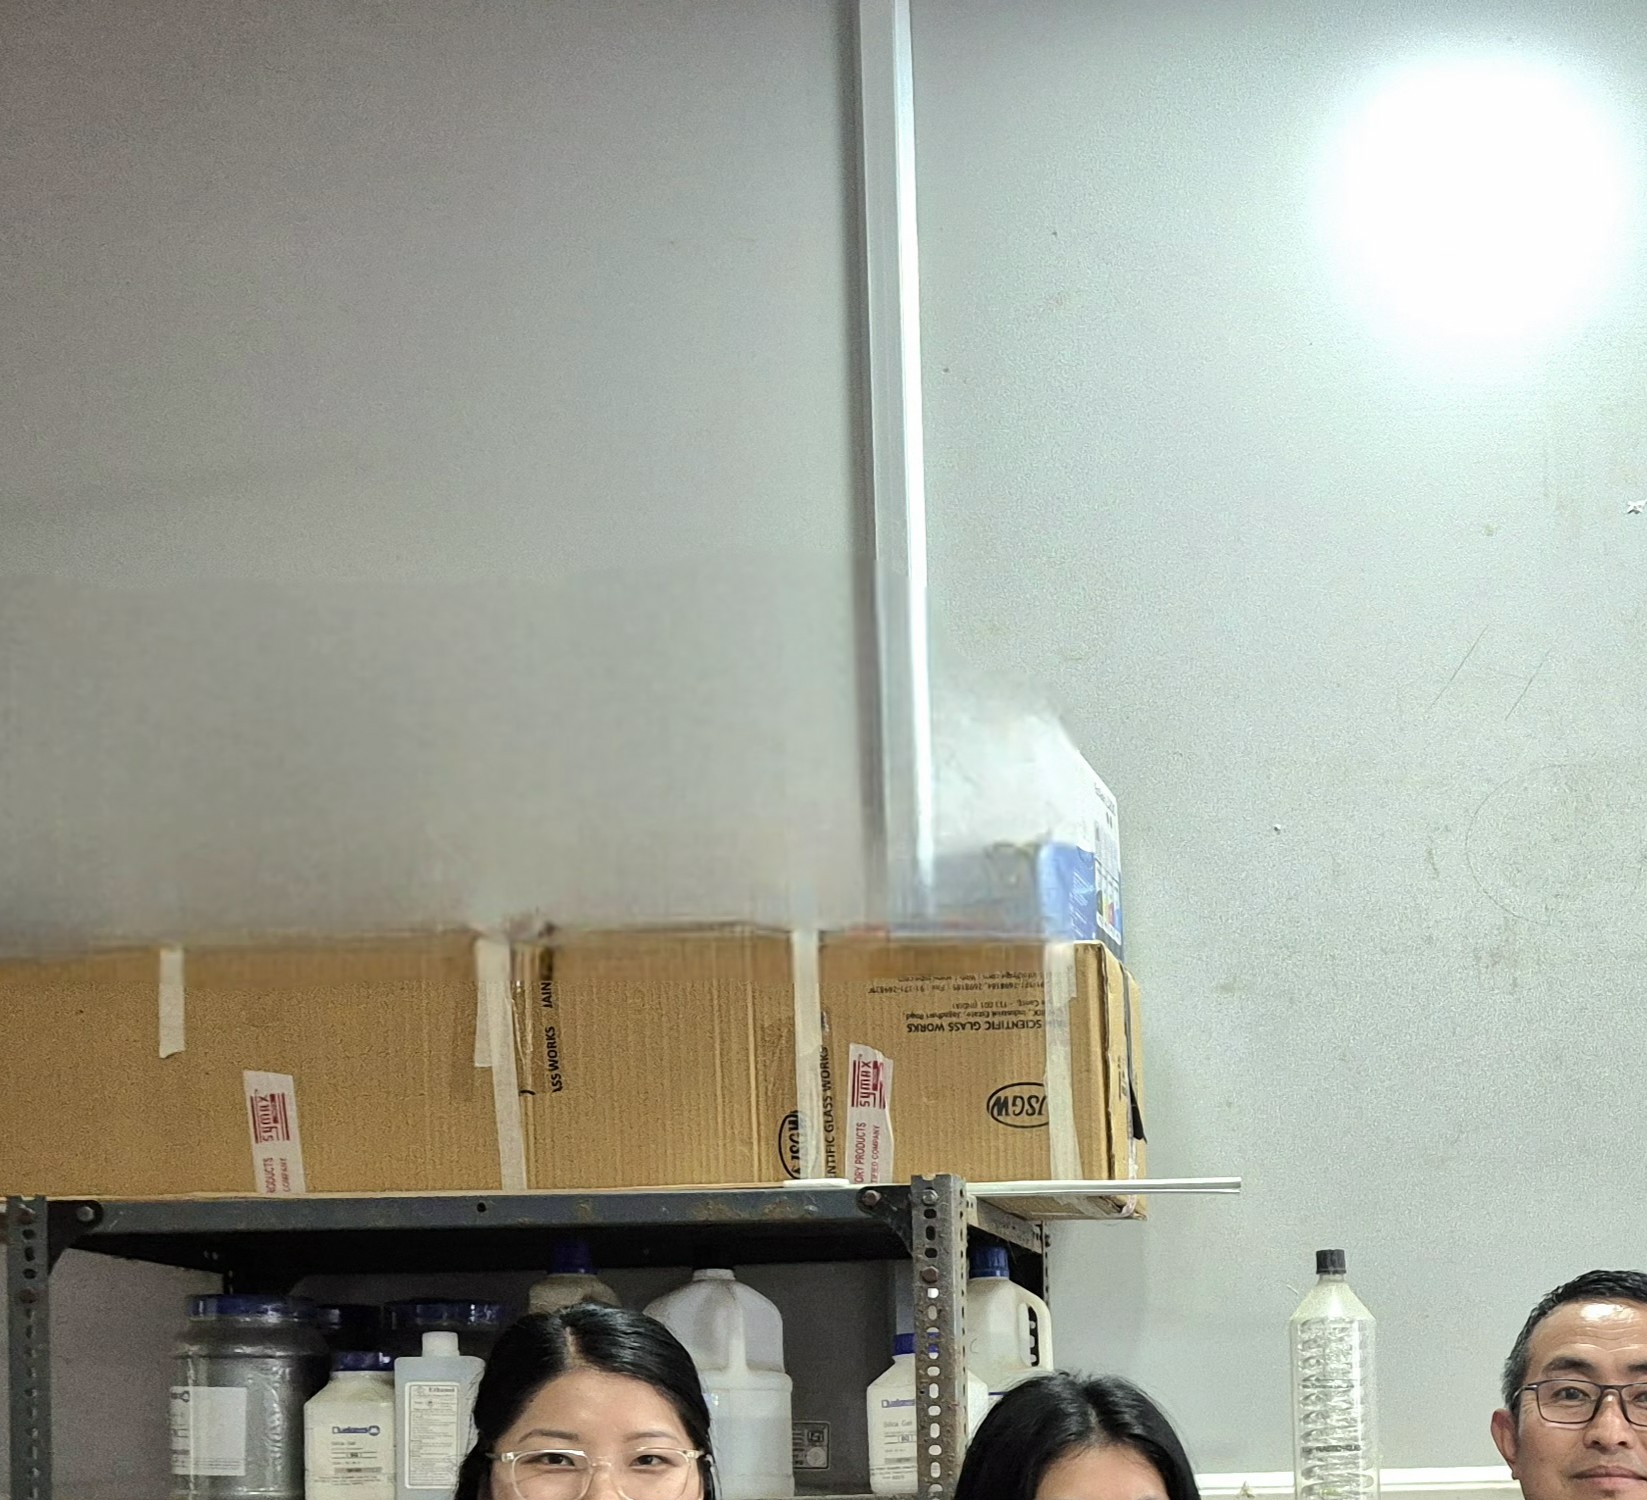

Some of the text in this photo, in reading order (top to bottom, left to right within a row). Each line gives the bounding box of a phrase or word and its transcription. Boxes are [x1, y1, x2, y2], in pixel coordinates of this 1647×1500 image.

[541, 981, 553, 1009] JAIN
[906, 1019, 1042, 1033] SCIENTIFIC GLASS WORKS
[545, 1026, 559, 1072] WORKS
[820, 1046, 837, 1179] NTIFIC GLASS WORKS
[856, 1122, 866, 1164] PRODUCTS
[872, 1125, 880, 1160] COMPANY
